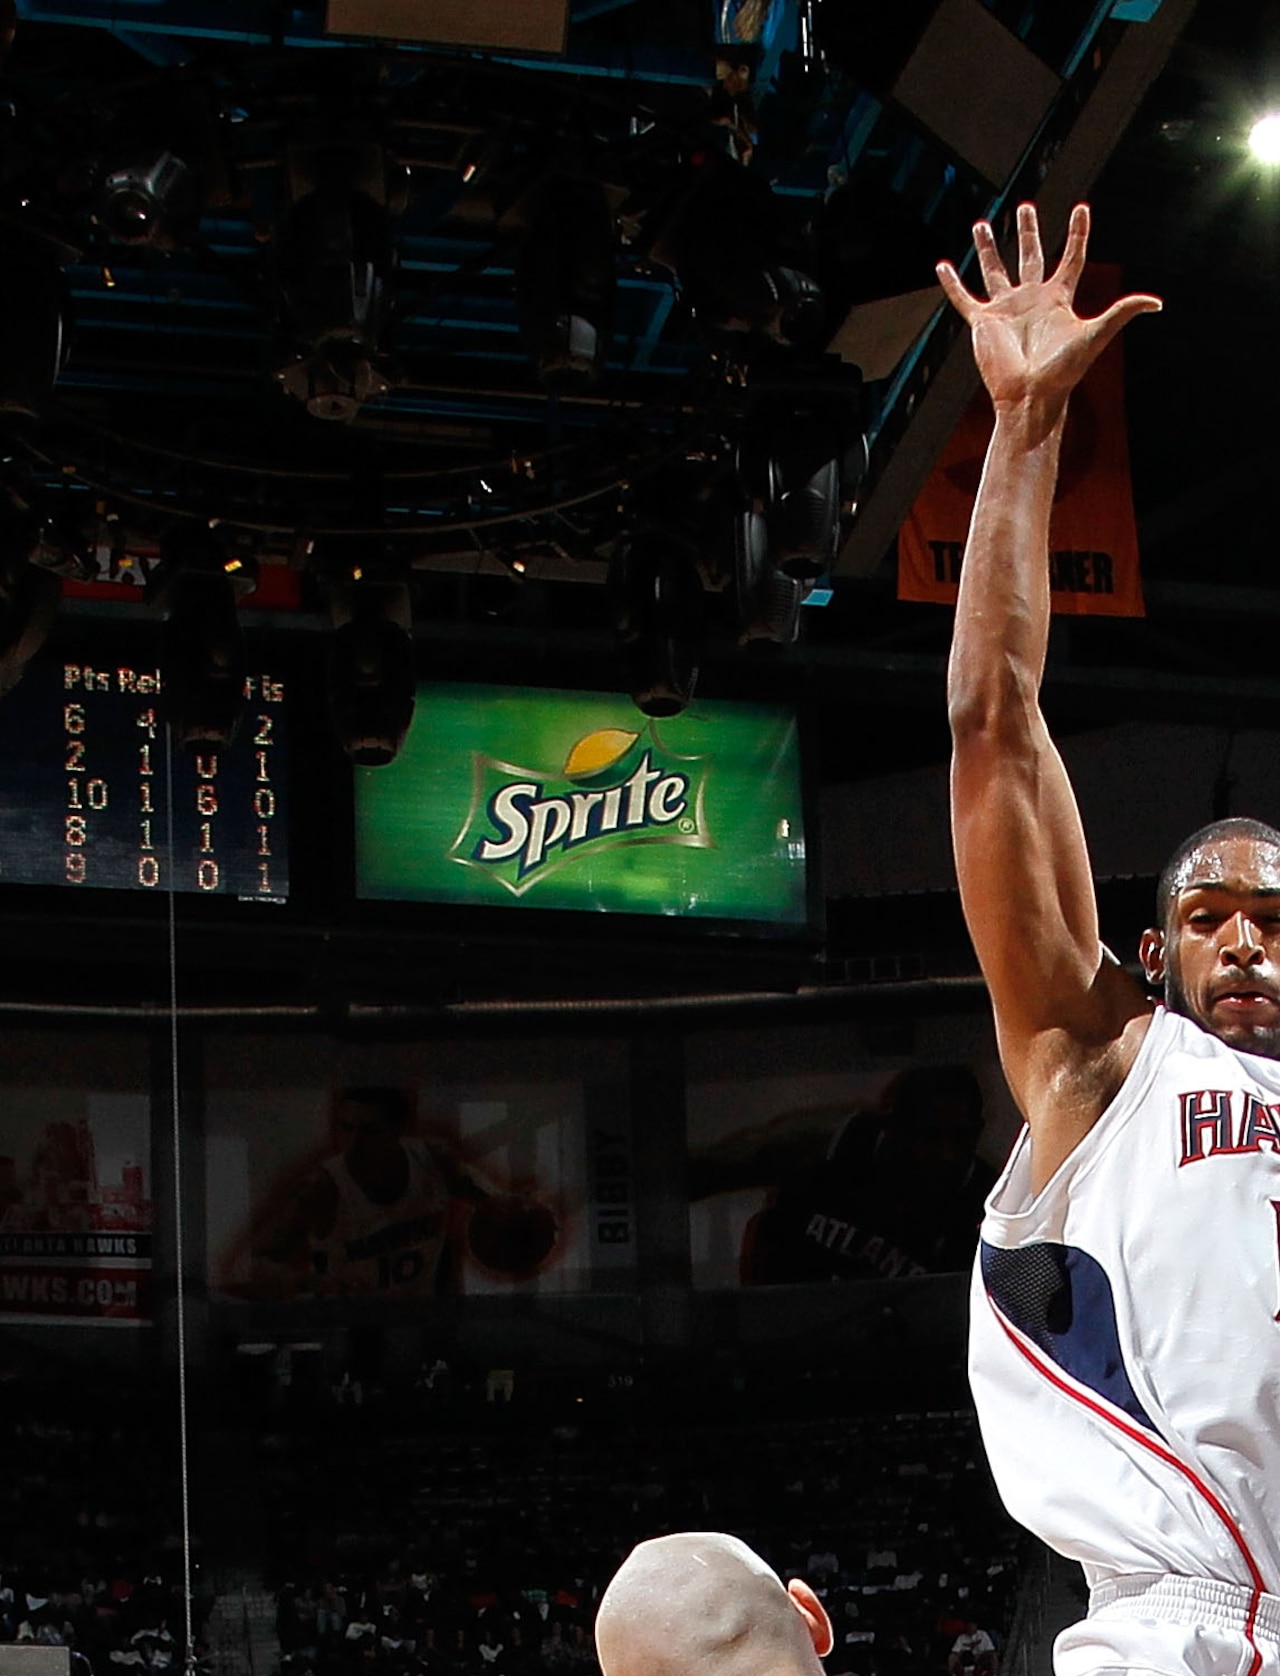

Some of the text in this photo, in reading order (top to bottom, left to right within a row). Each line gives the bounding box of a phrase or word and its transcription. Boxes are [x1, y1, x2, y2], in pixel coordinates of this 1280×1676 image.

[63, 663, 111, 692] Pts
[63, 701, 275, 746] 6 4 2
[64, 738, 88, 772] 2
[138, 743, 155, 776] 1
[255, 749, 271, 782] 1
[66, 776, 277, 819] 10 1 6 0
[477, 750, 688, 871] Sprite
[64, 813, 272, 856] 8 1 1 1
[138, 855, 161, 887] 0
[198, 858, 220, 890] 0
[258, 861, 273, 893] 1
[597, 1129, 630, 1243] BIBBY
[73, 1235, 137, 1256] HAWKS
[607, 1374, 634, 1390] 319
